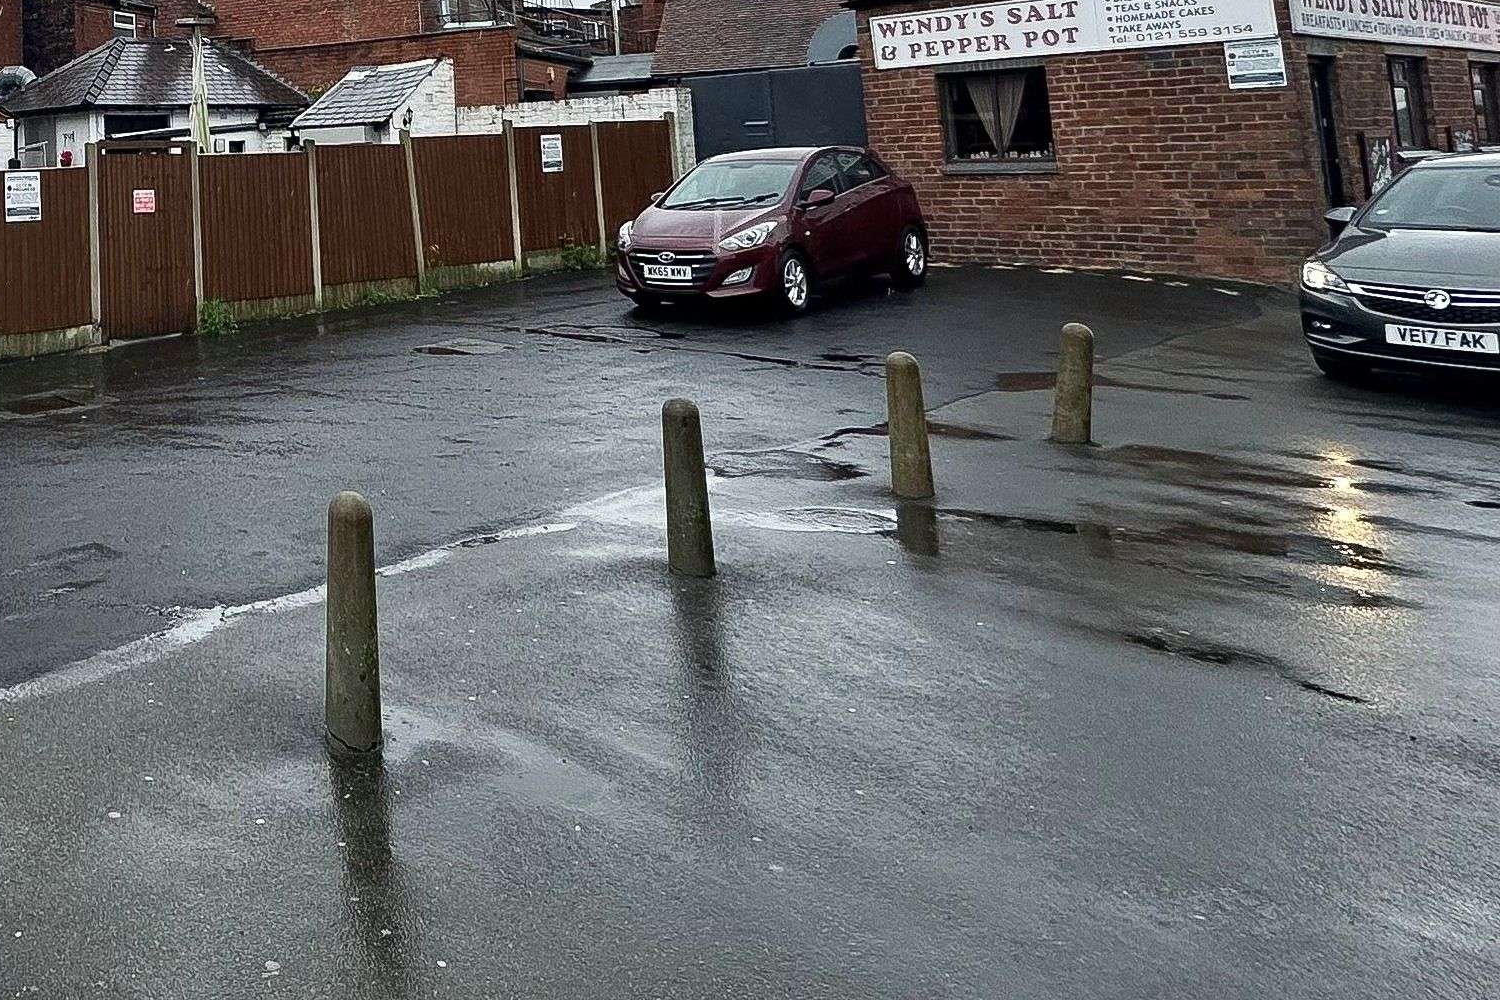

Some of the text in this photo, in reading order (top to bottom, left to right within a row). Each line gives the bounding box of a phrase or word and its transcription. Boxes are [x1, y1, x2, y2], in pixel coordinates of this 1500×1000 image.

[1114, 4, 1140, 13] TEAS
[1144, 2, 1151, 10] &
[1115, 6, 1215, 23] HOMEMADE CAKES
[1467, 5, 1490, 29] POT
[877, 1, 1078, 38] WENDY'S SALT
[1116, 20, 1182, 33] TAKE AWAYS
[1136, 32, 1172, 42] 0121
[1212, 24, 1253, 35] 3154
[881, 27, 1079, 61] & PEPPER POT
[1397, 326, 1486, 350] VE17 FAK
